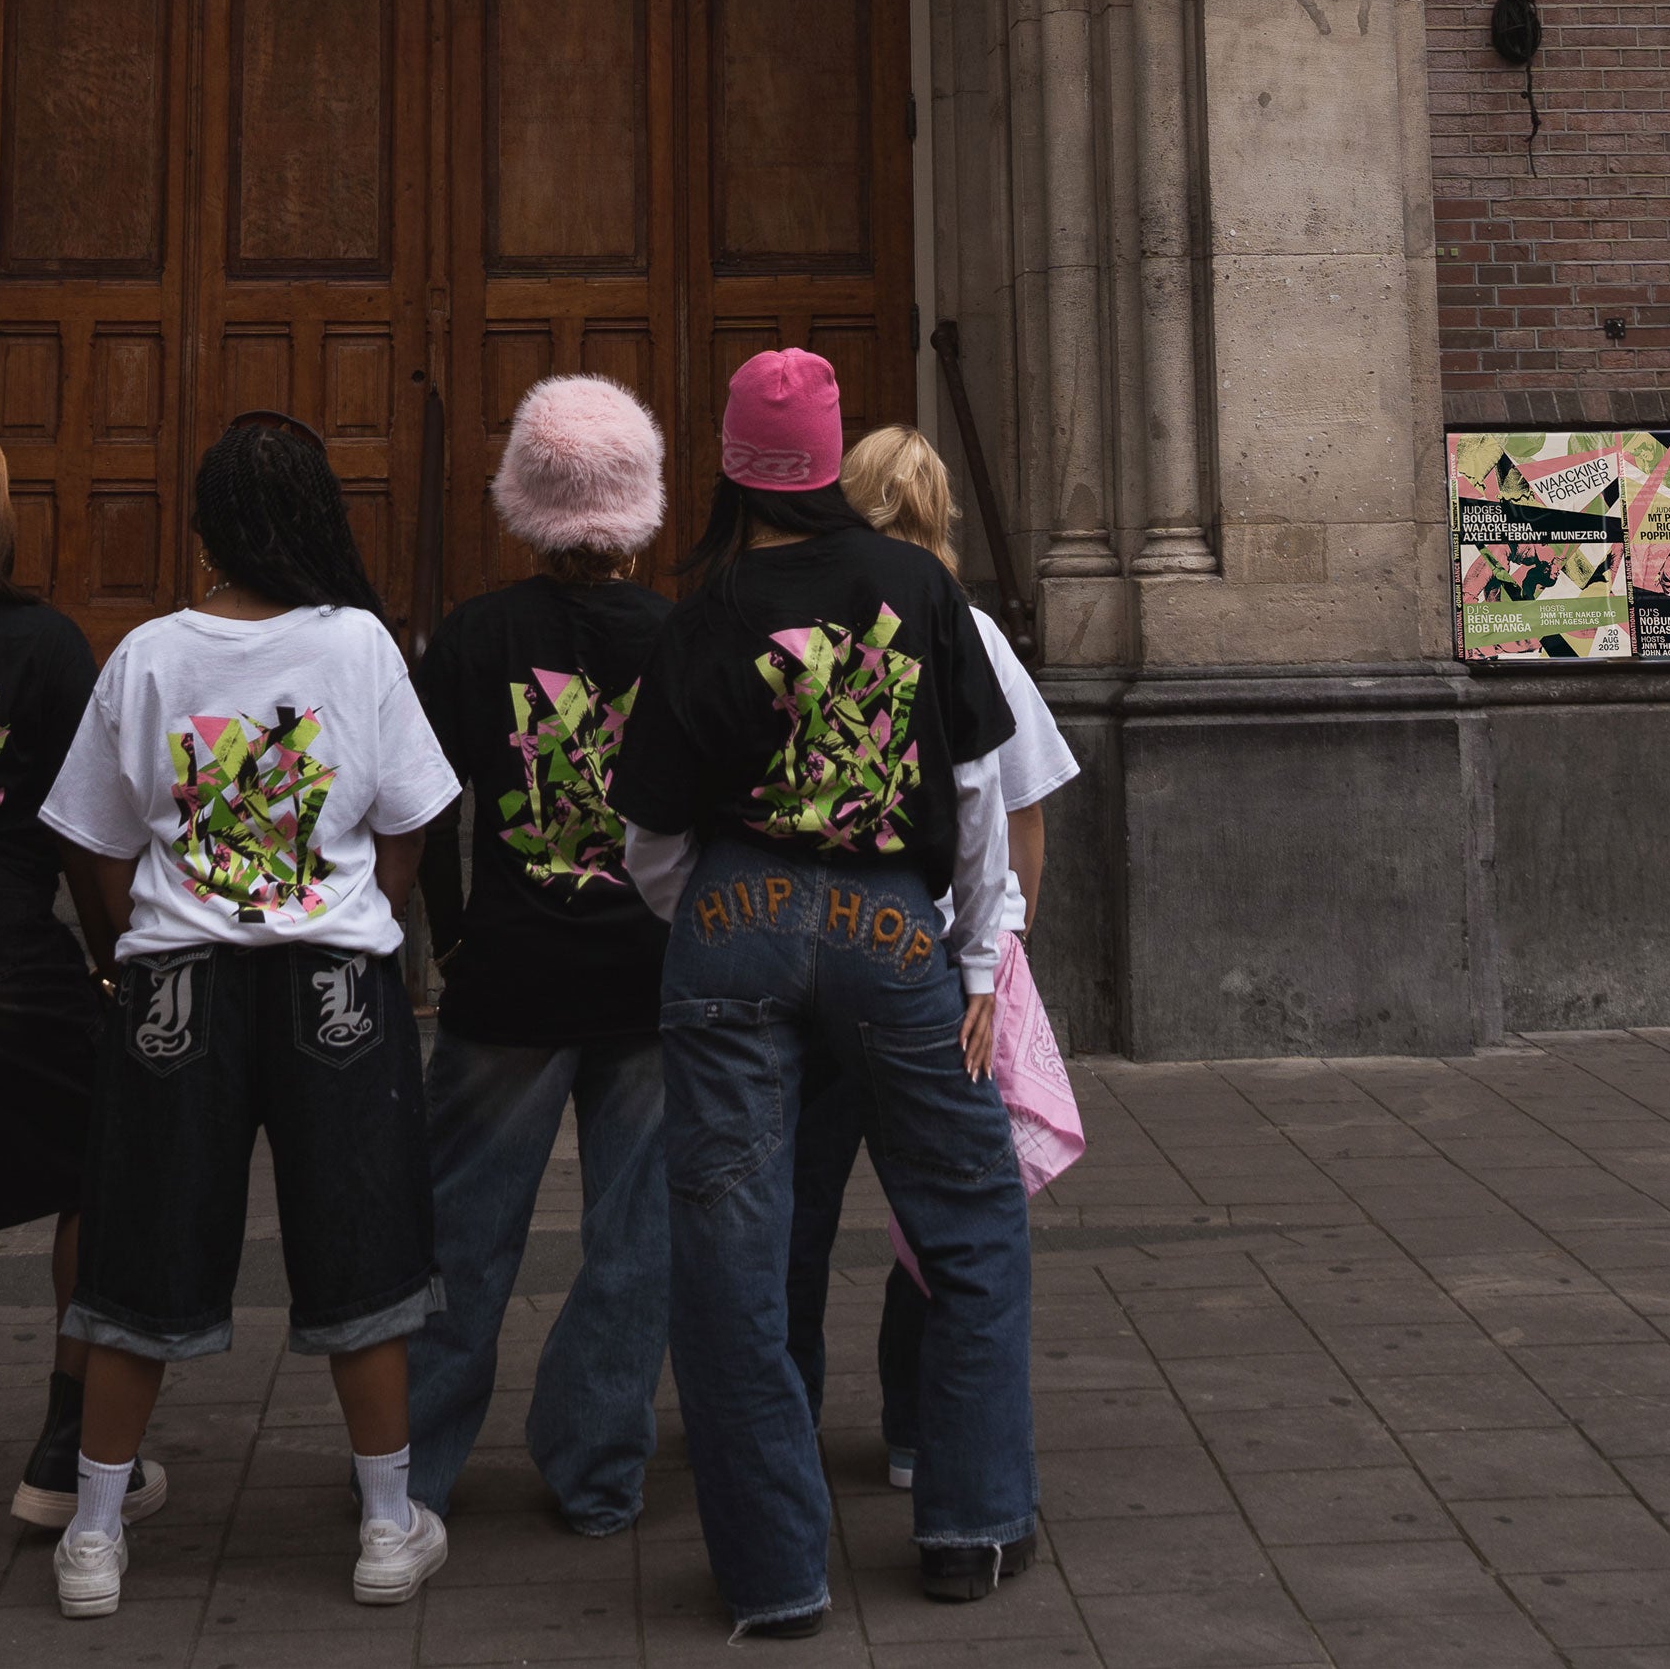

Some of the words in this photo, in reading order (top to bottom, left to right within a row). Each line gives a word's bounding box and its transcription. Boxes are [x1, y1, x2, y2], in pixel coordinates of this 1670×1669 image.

[1534, 458, 1609, 494] WAACKING
[1548, 472, 1612, 504] FOREVER
[1462, 505, 1502, 515] JUDGES
[1463, 514, 1507, 523] BOUBOU
[1647, 514, 1663, 523] MT
[1462, 523, 1534, 532] WAACKEISHA
[1463, 532, 1502, 541] AXELLE
[1551, 530, 1608, 540] MUNEZERO
[1467, 614, 1523, 624] RENEGADE
[1540, 611, 1559, 619] JNM
[1603, 610, 1617, 618] MC
[1541, 618, 1561, 626] JOHN
[1468, 623, 1491, 633] ROB
[1493, 622, 1532, 633] MANGA
[1598, 643, 1620, 651] 2025
[697, 876, 793, 940] HIP
[826, 886, 932, 971] HOP
